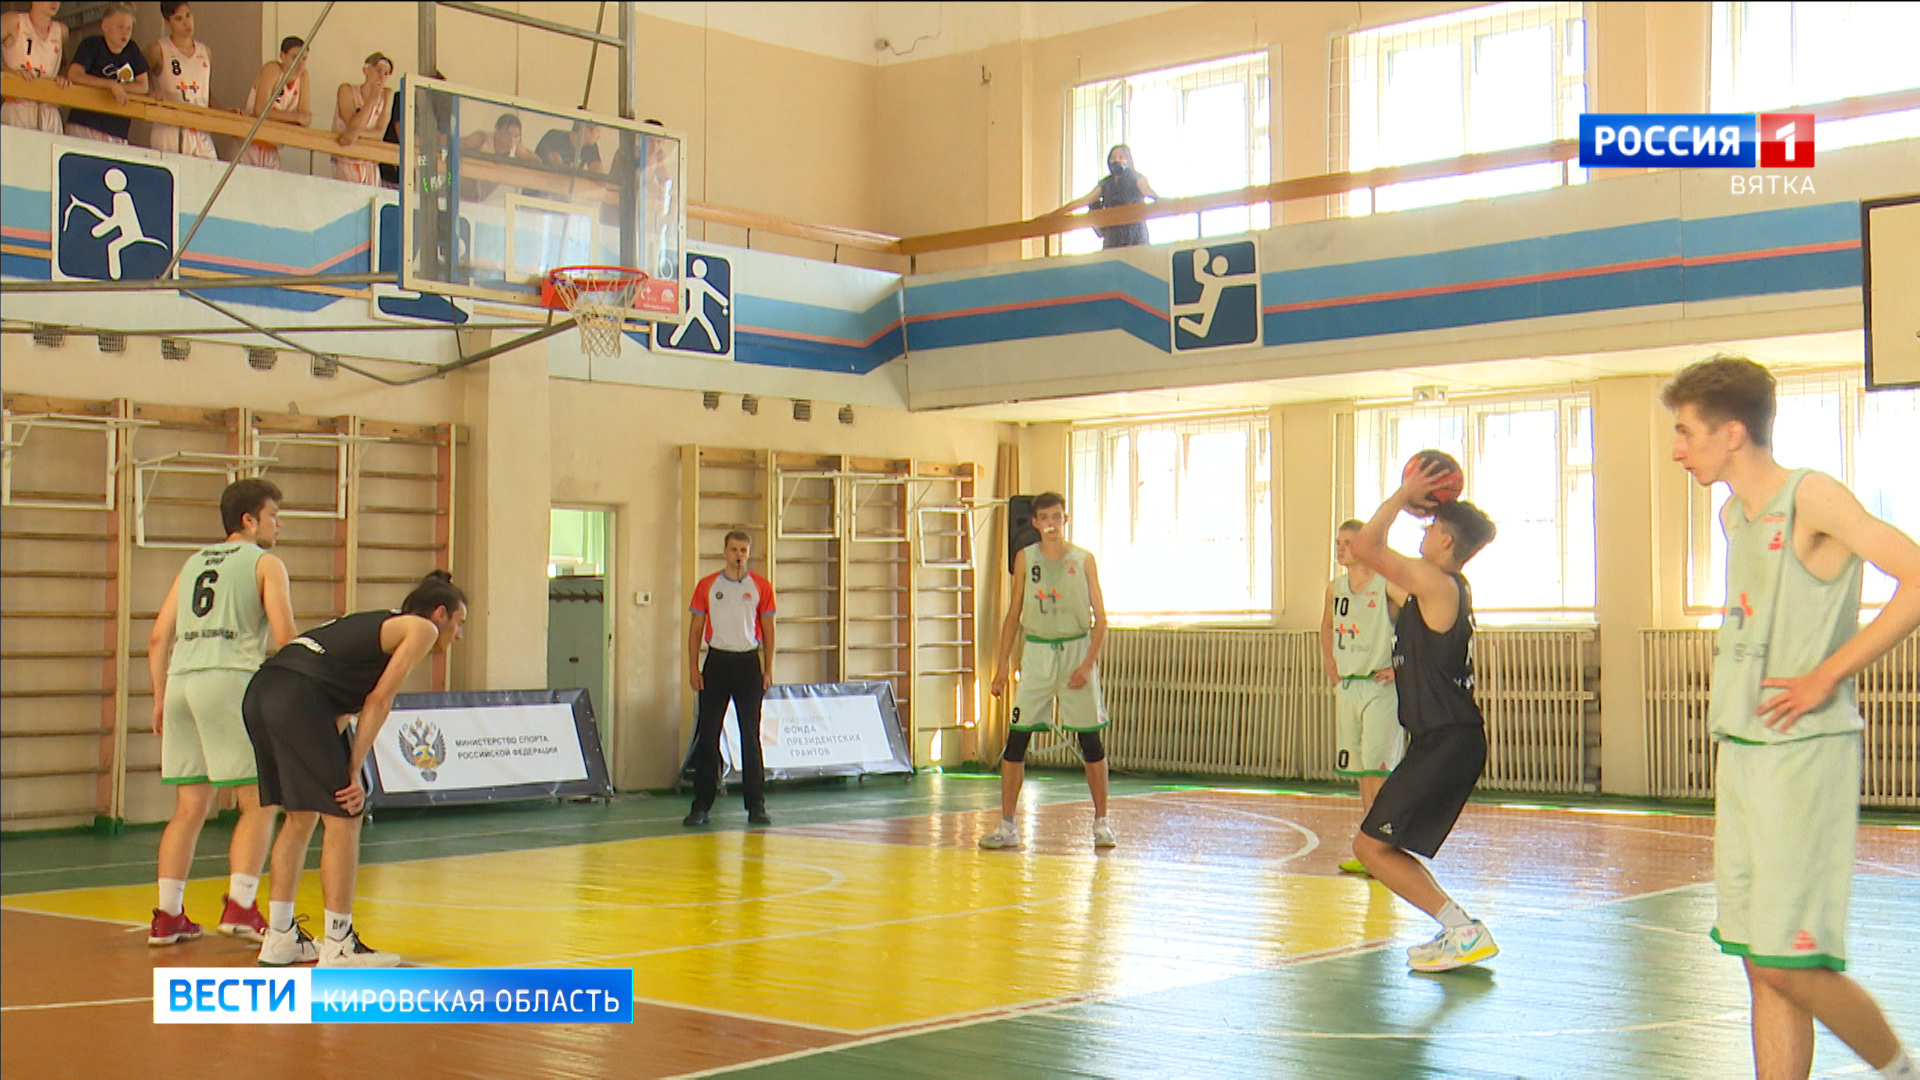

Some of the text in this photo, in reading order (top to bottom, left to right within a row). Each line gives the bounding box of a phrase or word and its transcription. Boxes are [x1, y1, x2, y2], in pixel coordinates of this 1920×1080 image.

[26, 38, 33, 55] 1
[171, 59, 182, 76] 8
[1031, 565, 1041, 583] 9
[191, 568, 219, 618] 6
[1011, 706, 1021, 724] 9
[783, 725, 817, 734] ФОНДА
[455, 735, 549, 747] МИНИСТЕРСТВО СПОРТА
[786, 733, 862, 746] ПРЕЗИДЕНТСКИХ
[457, 746, 559, 760] РОССИЙСКОЙ ФЕДЕРАЦИИ
[789, 747, 831, 758] ГРАНТОВ
